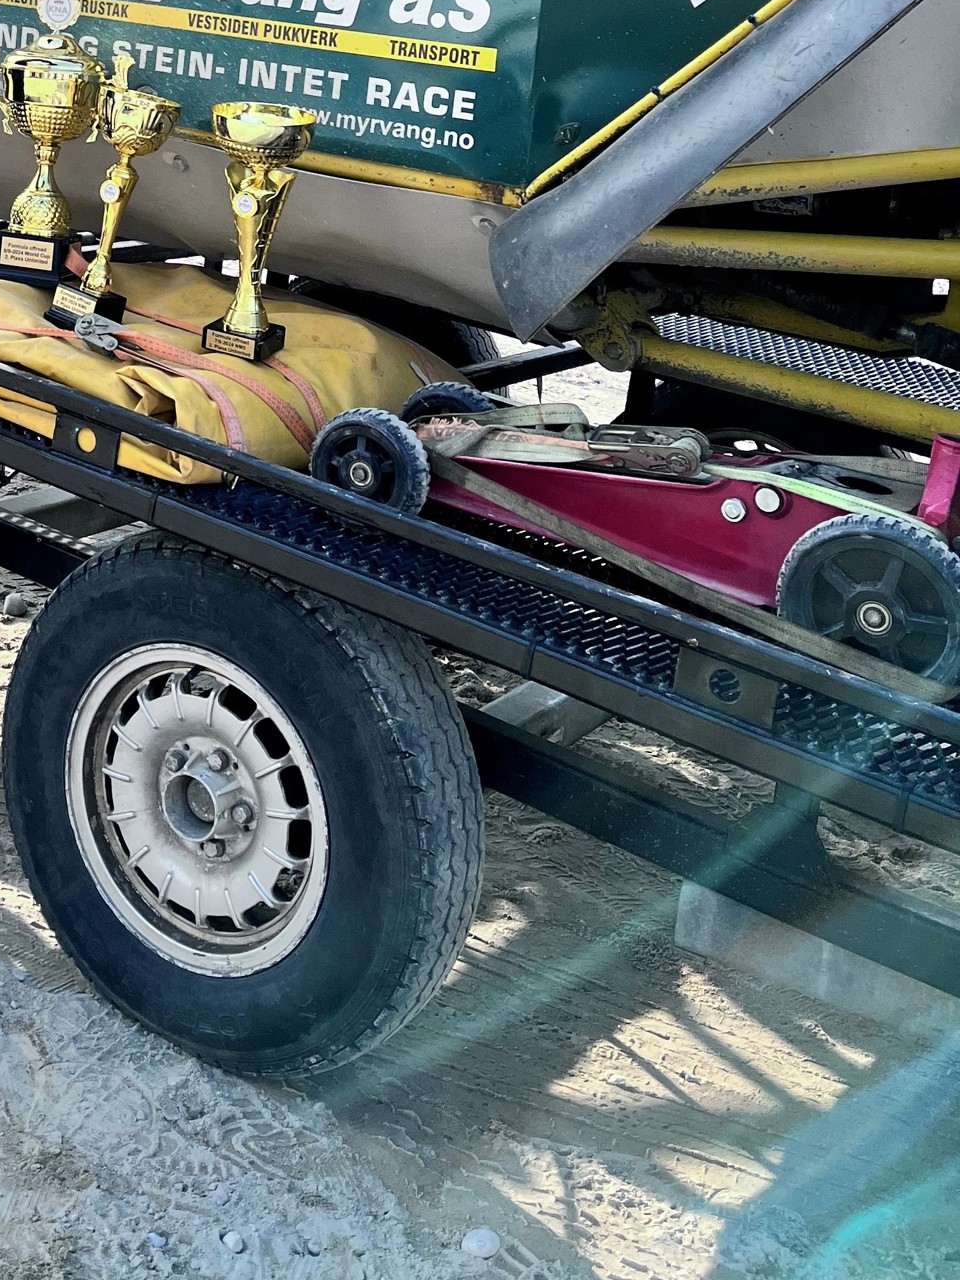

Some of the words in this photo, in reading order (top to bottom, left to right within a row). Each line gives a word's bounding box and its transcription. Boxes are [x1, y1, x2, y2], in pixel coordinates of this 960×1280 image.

[188, 12, 259, 37] VESTSIDEN
[263, 23, 339, 48] PUKKVERK
[389, 39, 480, 67] TRANSPORT
[238, 57, 349, 100] INTET
[366, 76, 477, 121] RACE
[301, 105, 475, 150] w.myrvang.no
